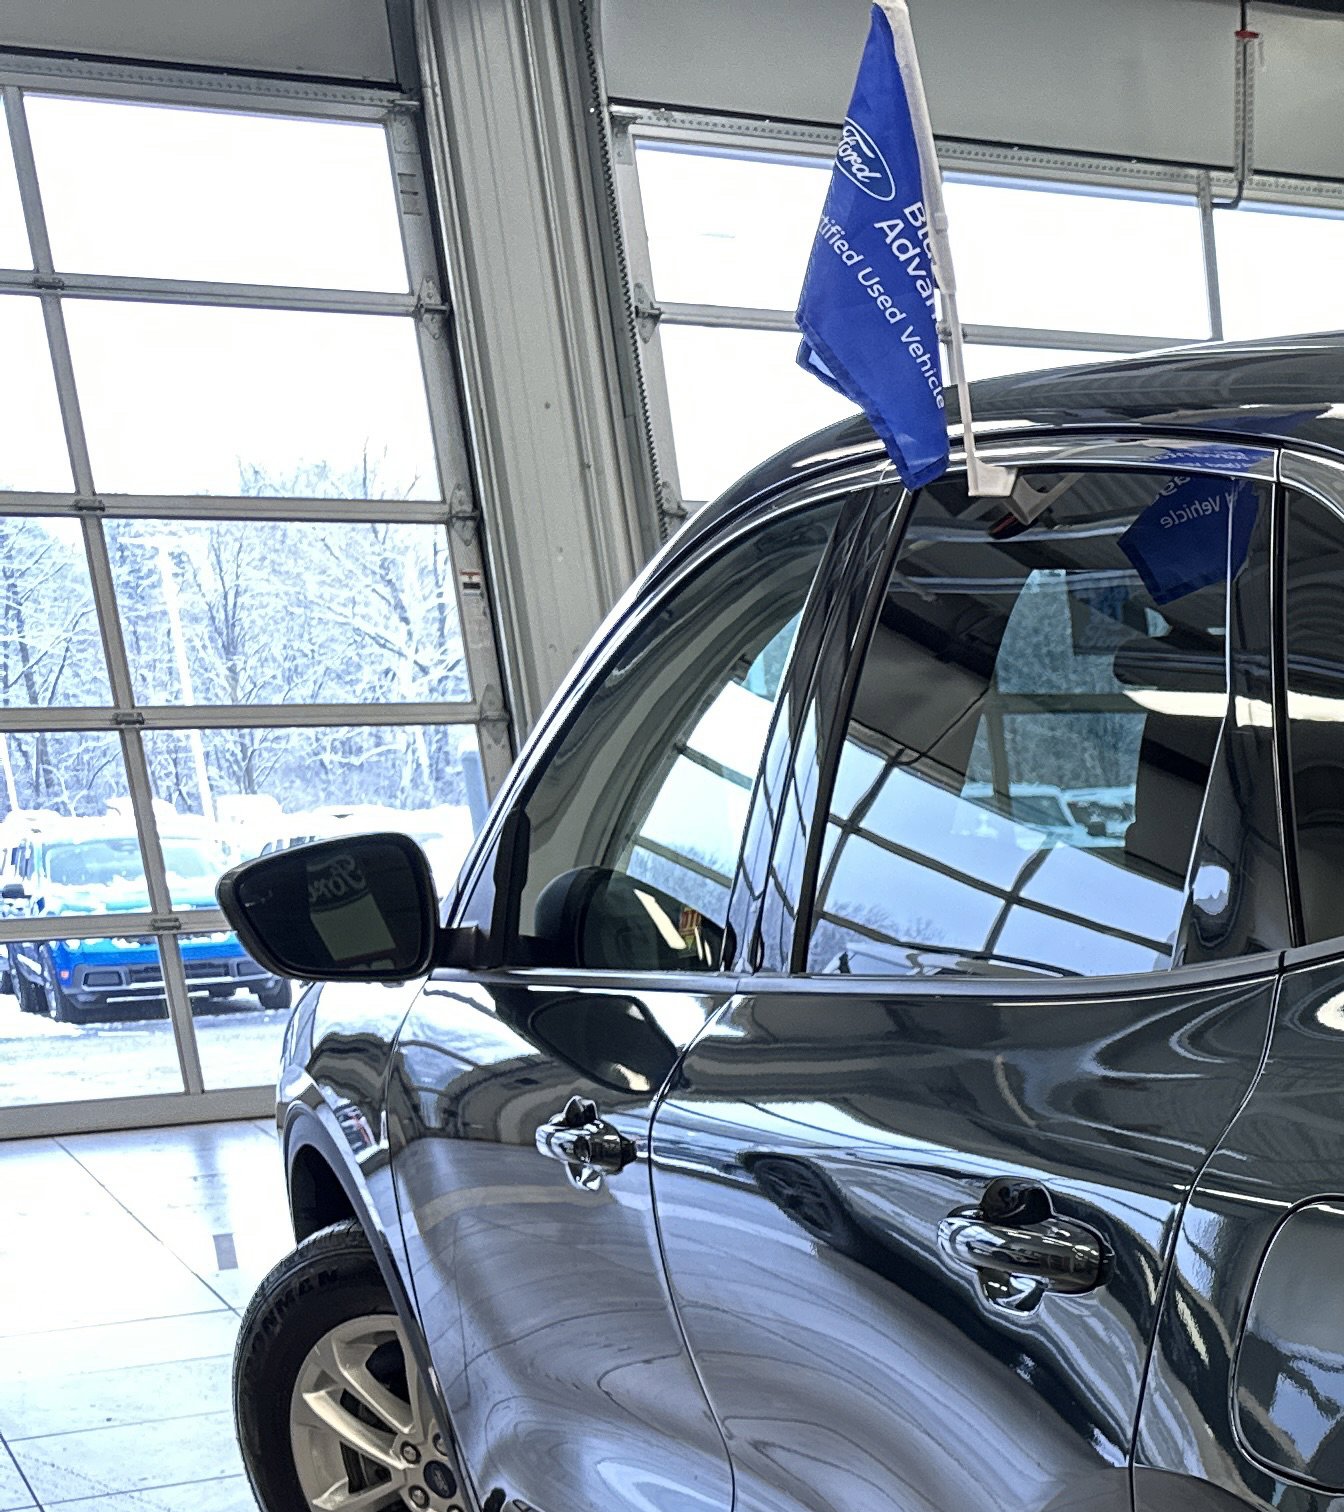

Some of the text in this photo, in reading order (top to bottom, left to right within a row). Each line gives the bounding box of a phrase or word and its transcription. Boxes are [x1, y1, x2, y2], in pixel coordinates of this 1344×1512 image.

[838, 125, 883, 183] Ford
[857, 266, 907, 324] Used
[900, 325, 945, 409] Vehicle
